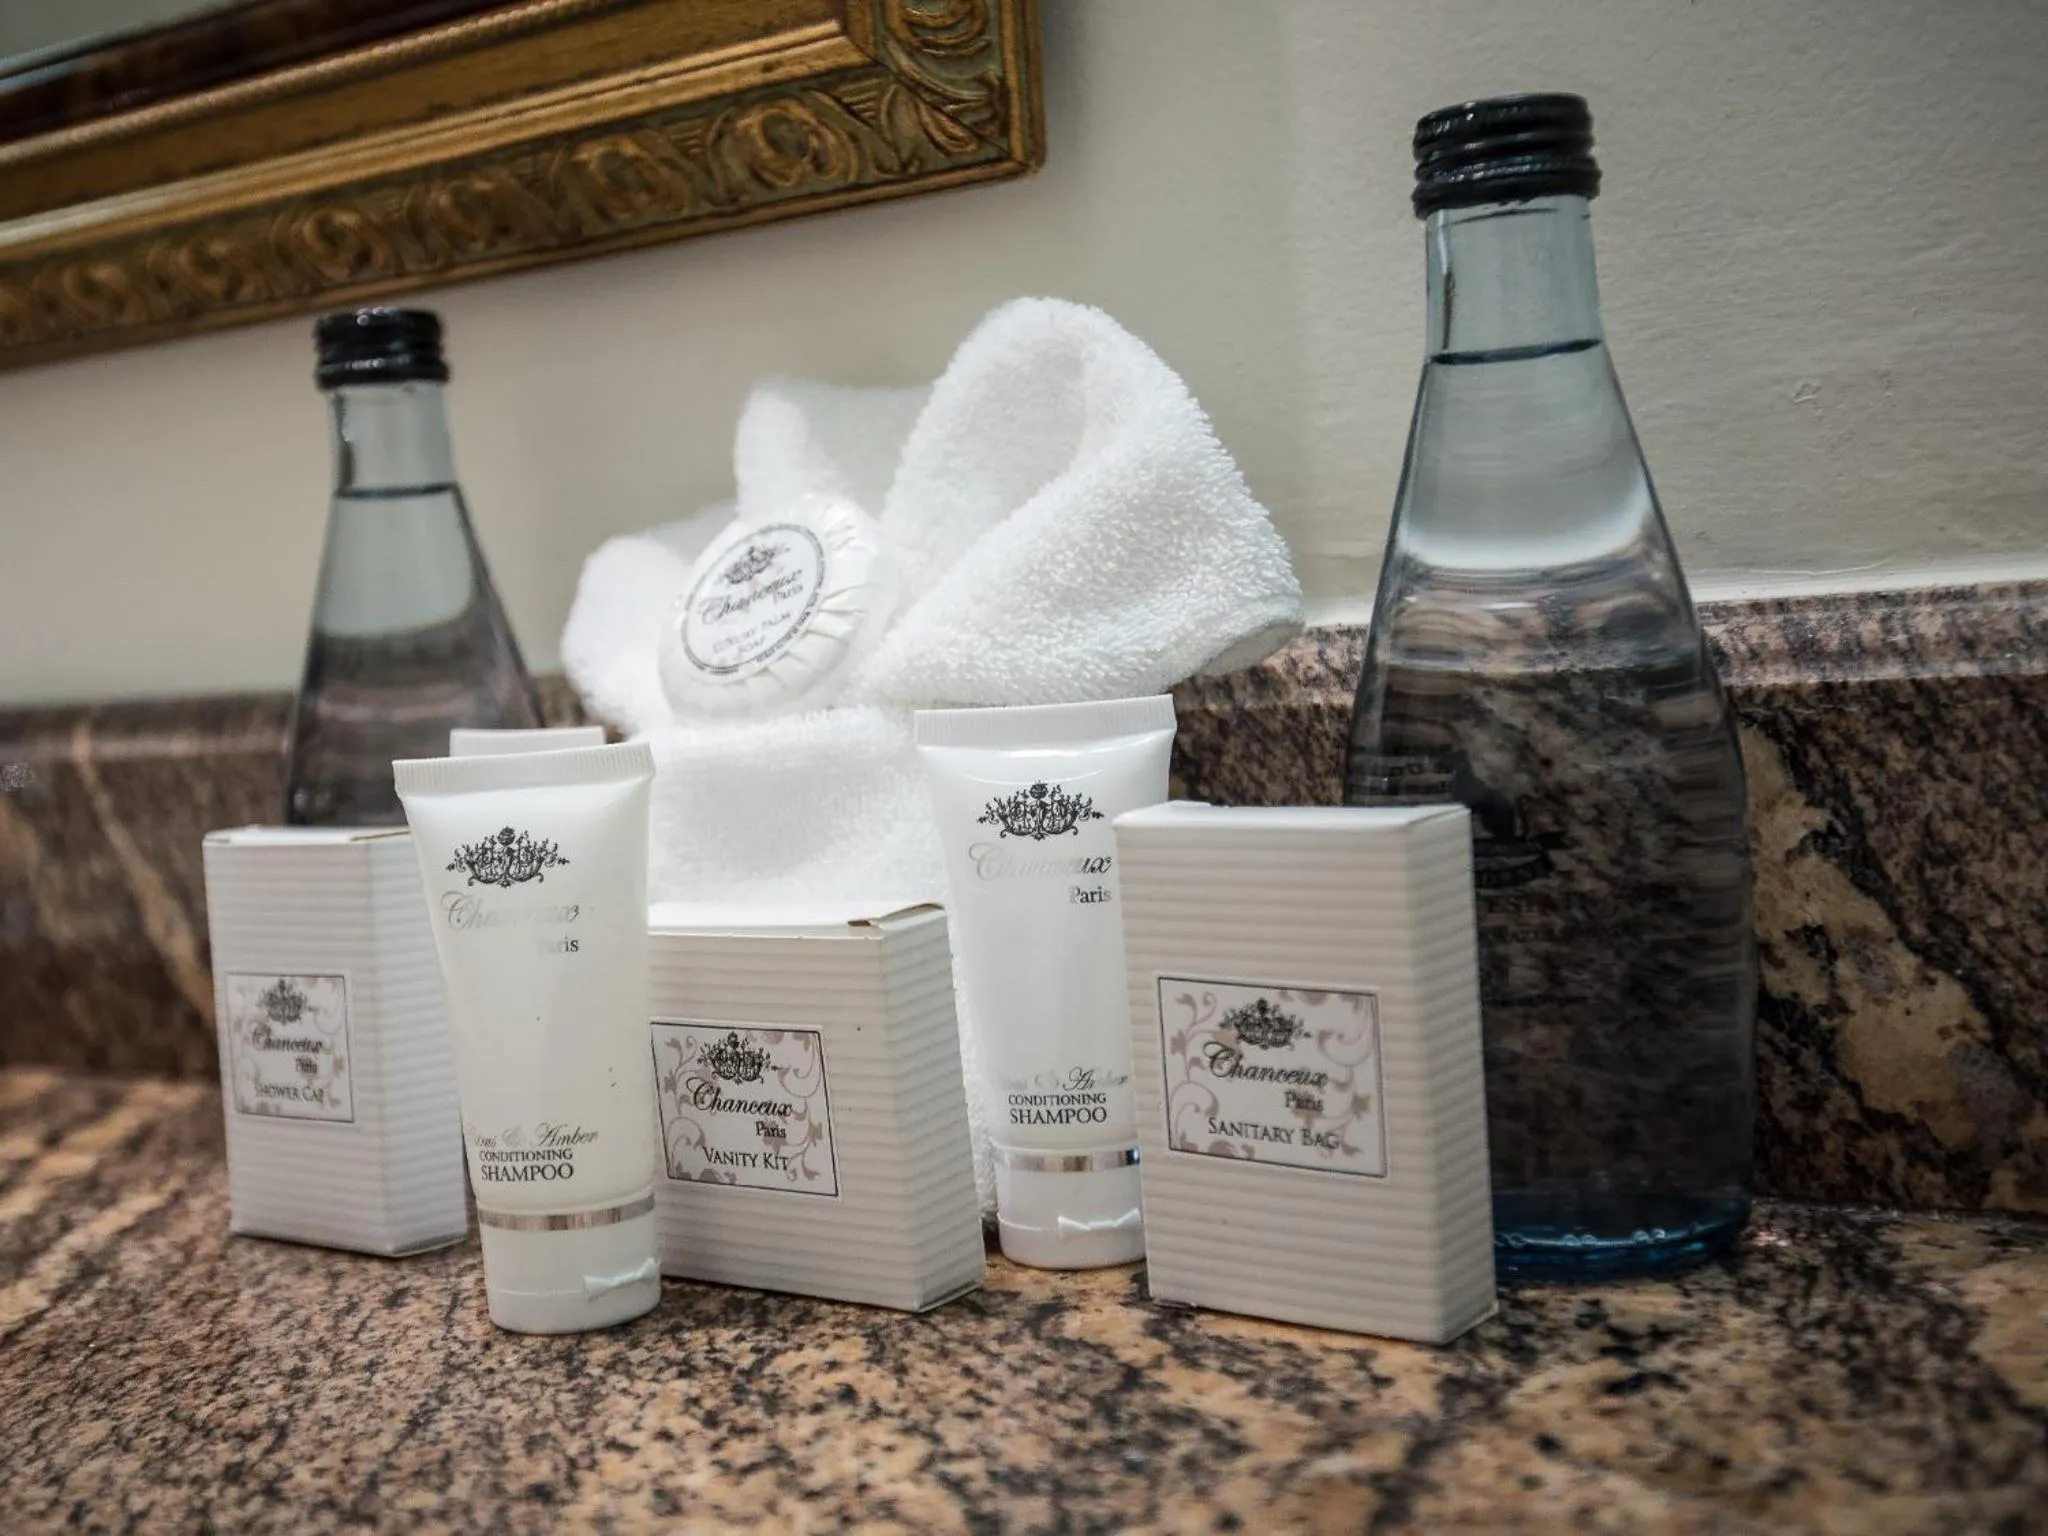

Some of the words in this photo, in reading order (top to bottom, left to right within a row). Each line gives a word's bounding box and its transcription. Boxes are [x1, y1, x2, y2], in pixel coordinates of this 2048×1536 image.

[686, 1077, 793, 1117] Chanceux
[1008, 1093, 1107, 1106] CONDITIONING
[1009, 1107, 1107, 1125] SHAMPOO
[535, 1122, 600, 1147] Amber
[756, 1120, 786, 1138] Paris
[1208, 1117, 1294, 1144] SANITARY
[1301, 1129, 1340, 1149] BAG
[479, 1148, 573, 1163] CONDITIONING
[702, 1145, 758, 1168] VANITY
[762, 1152, 789, 1171] KIT
[481, 1163, 574, 1182] SHAMPOO
